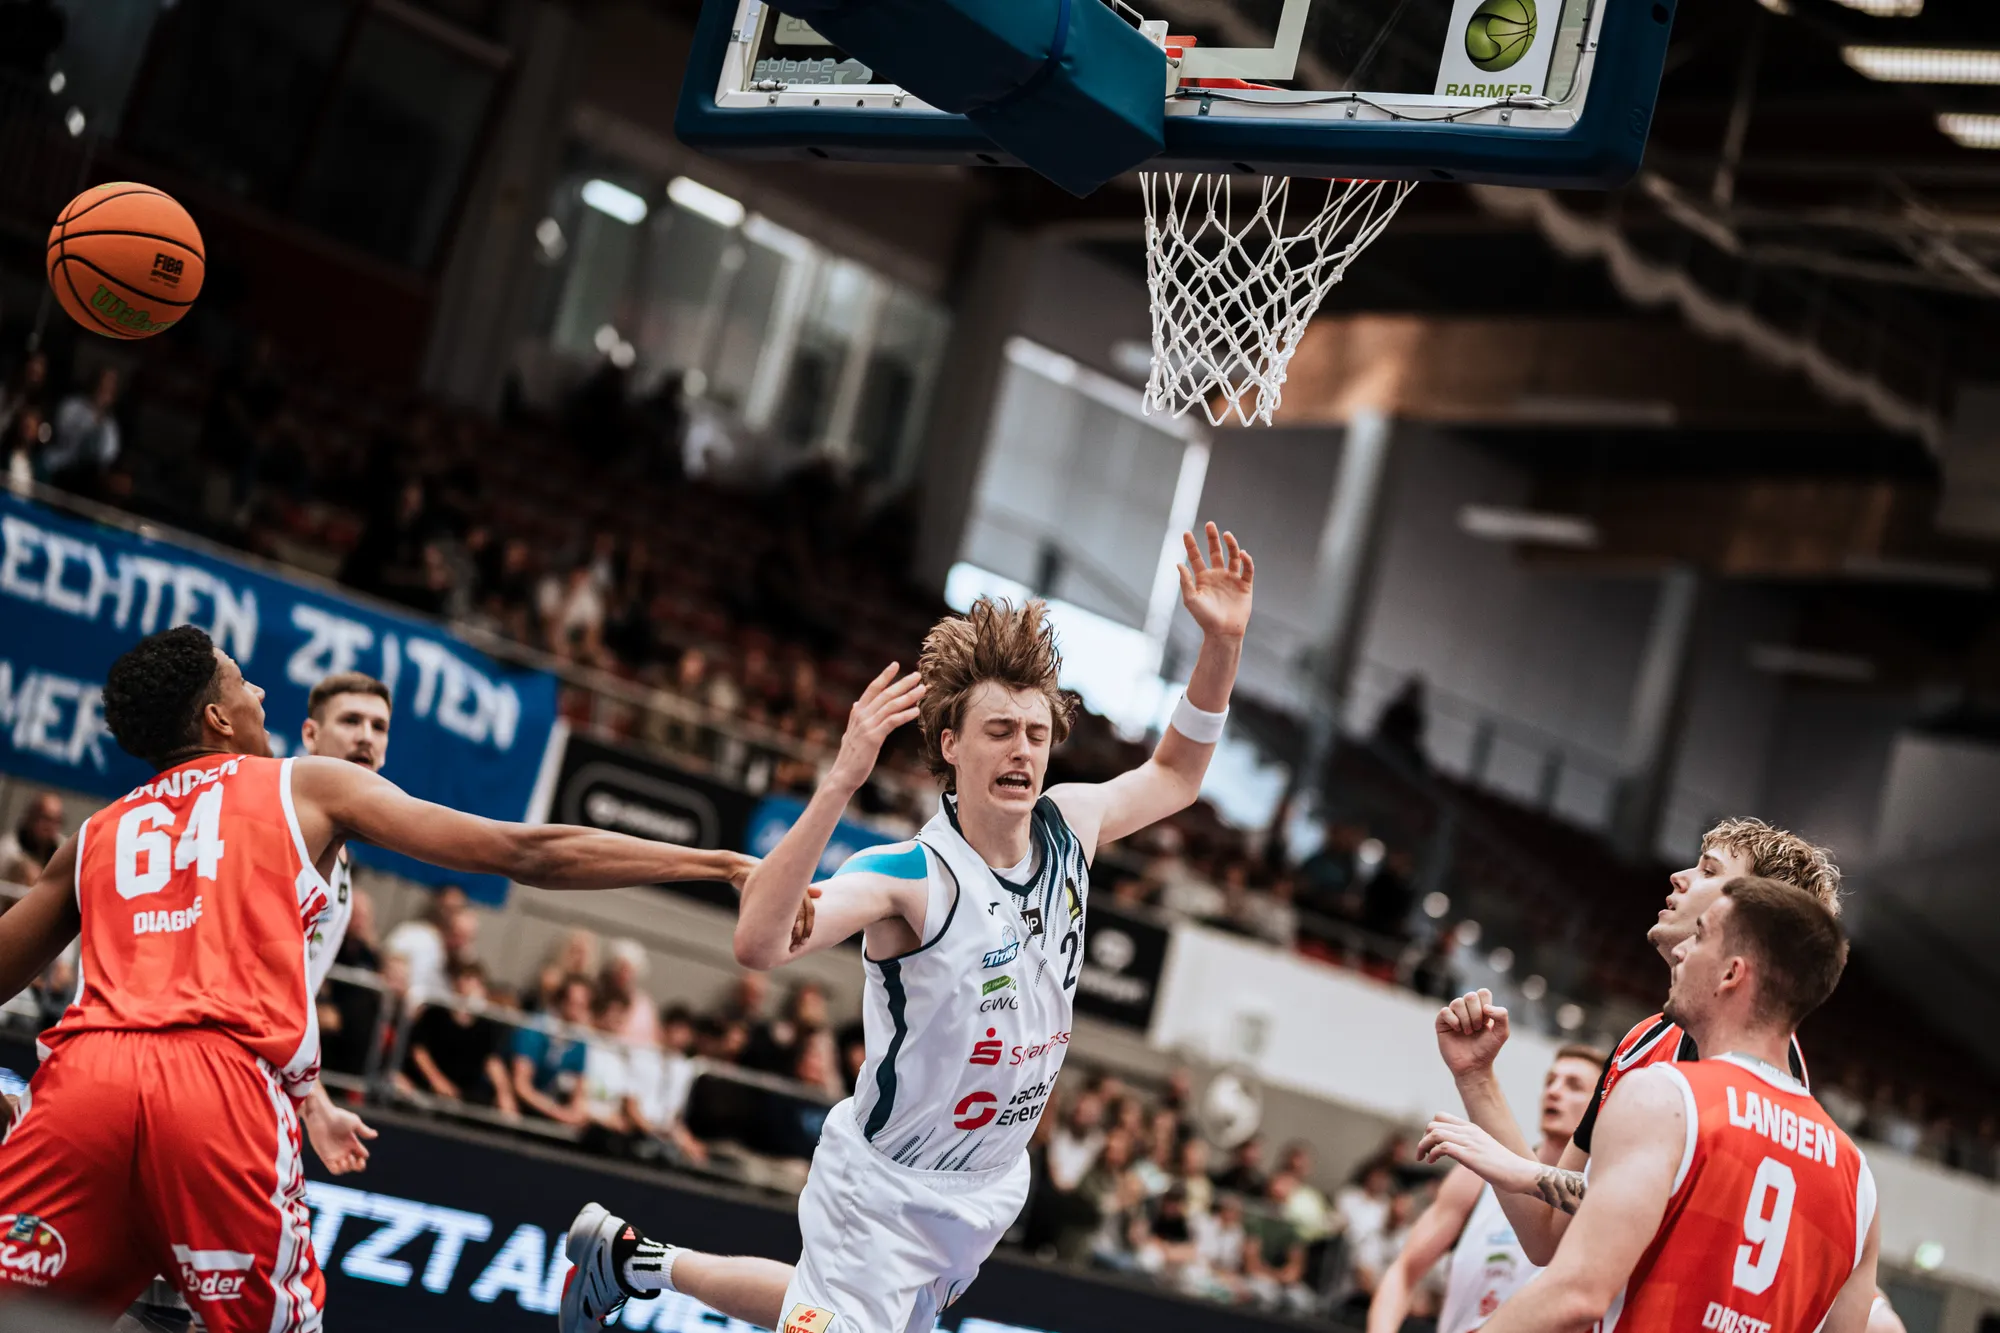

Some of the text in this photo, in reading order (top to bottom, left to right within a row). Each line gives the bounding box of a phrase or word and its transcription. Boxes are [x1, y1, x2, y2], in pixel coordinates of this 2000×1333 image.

[153, 253, 184, 276] FIBA
[0, 514, 258, 664] ECHTEN
[114, 781, 225, 901] 64
[1726, 1086, 1837, 1168] LANGEN
[1732, 1156, 1797, 1295] 9
